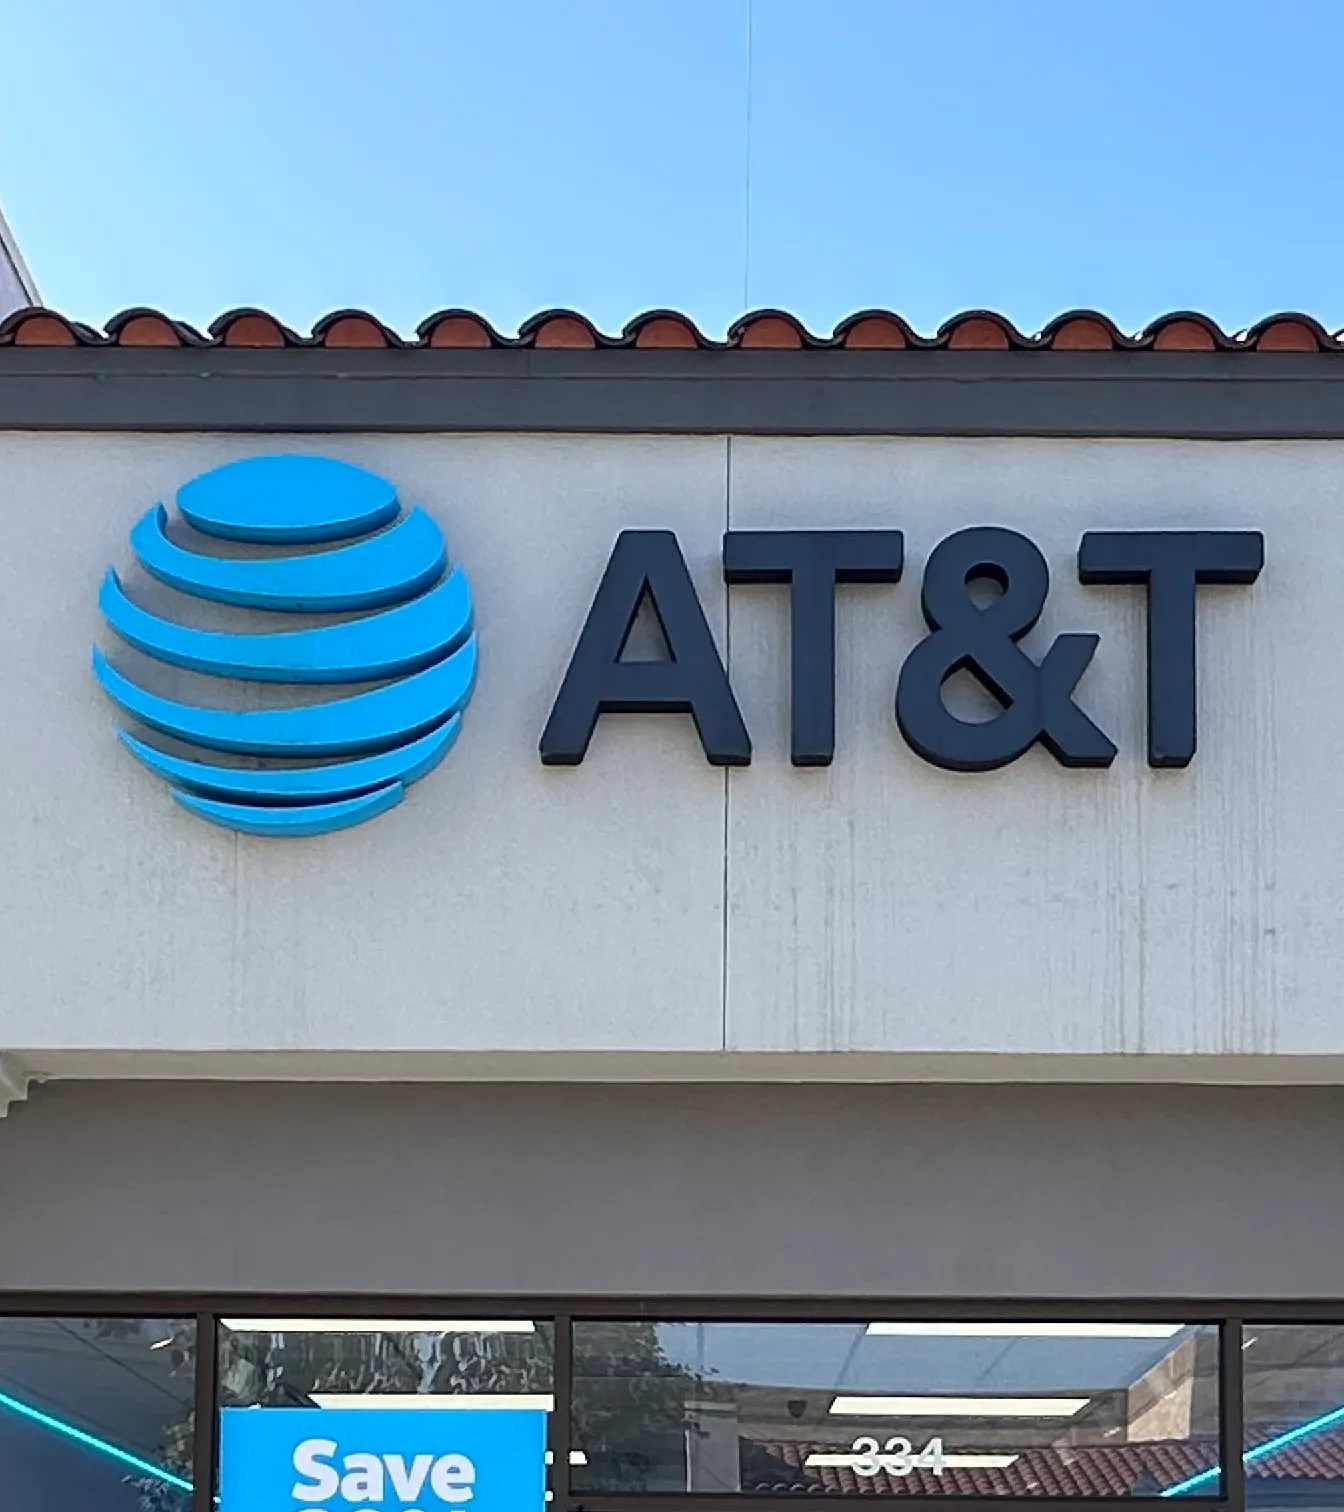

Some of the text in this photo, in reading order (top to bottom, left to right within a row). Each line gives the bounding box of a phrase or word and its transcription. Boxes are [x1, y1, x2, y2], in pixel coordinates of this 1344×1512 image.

[539, 526, 1265, 771] AT&T
[291, 1438, 476, 1502] Save
[851, 1437, 947, 1477] 334
